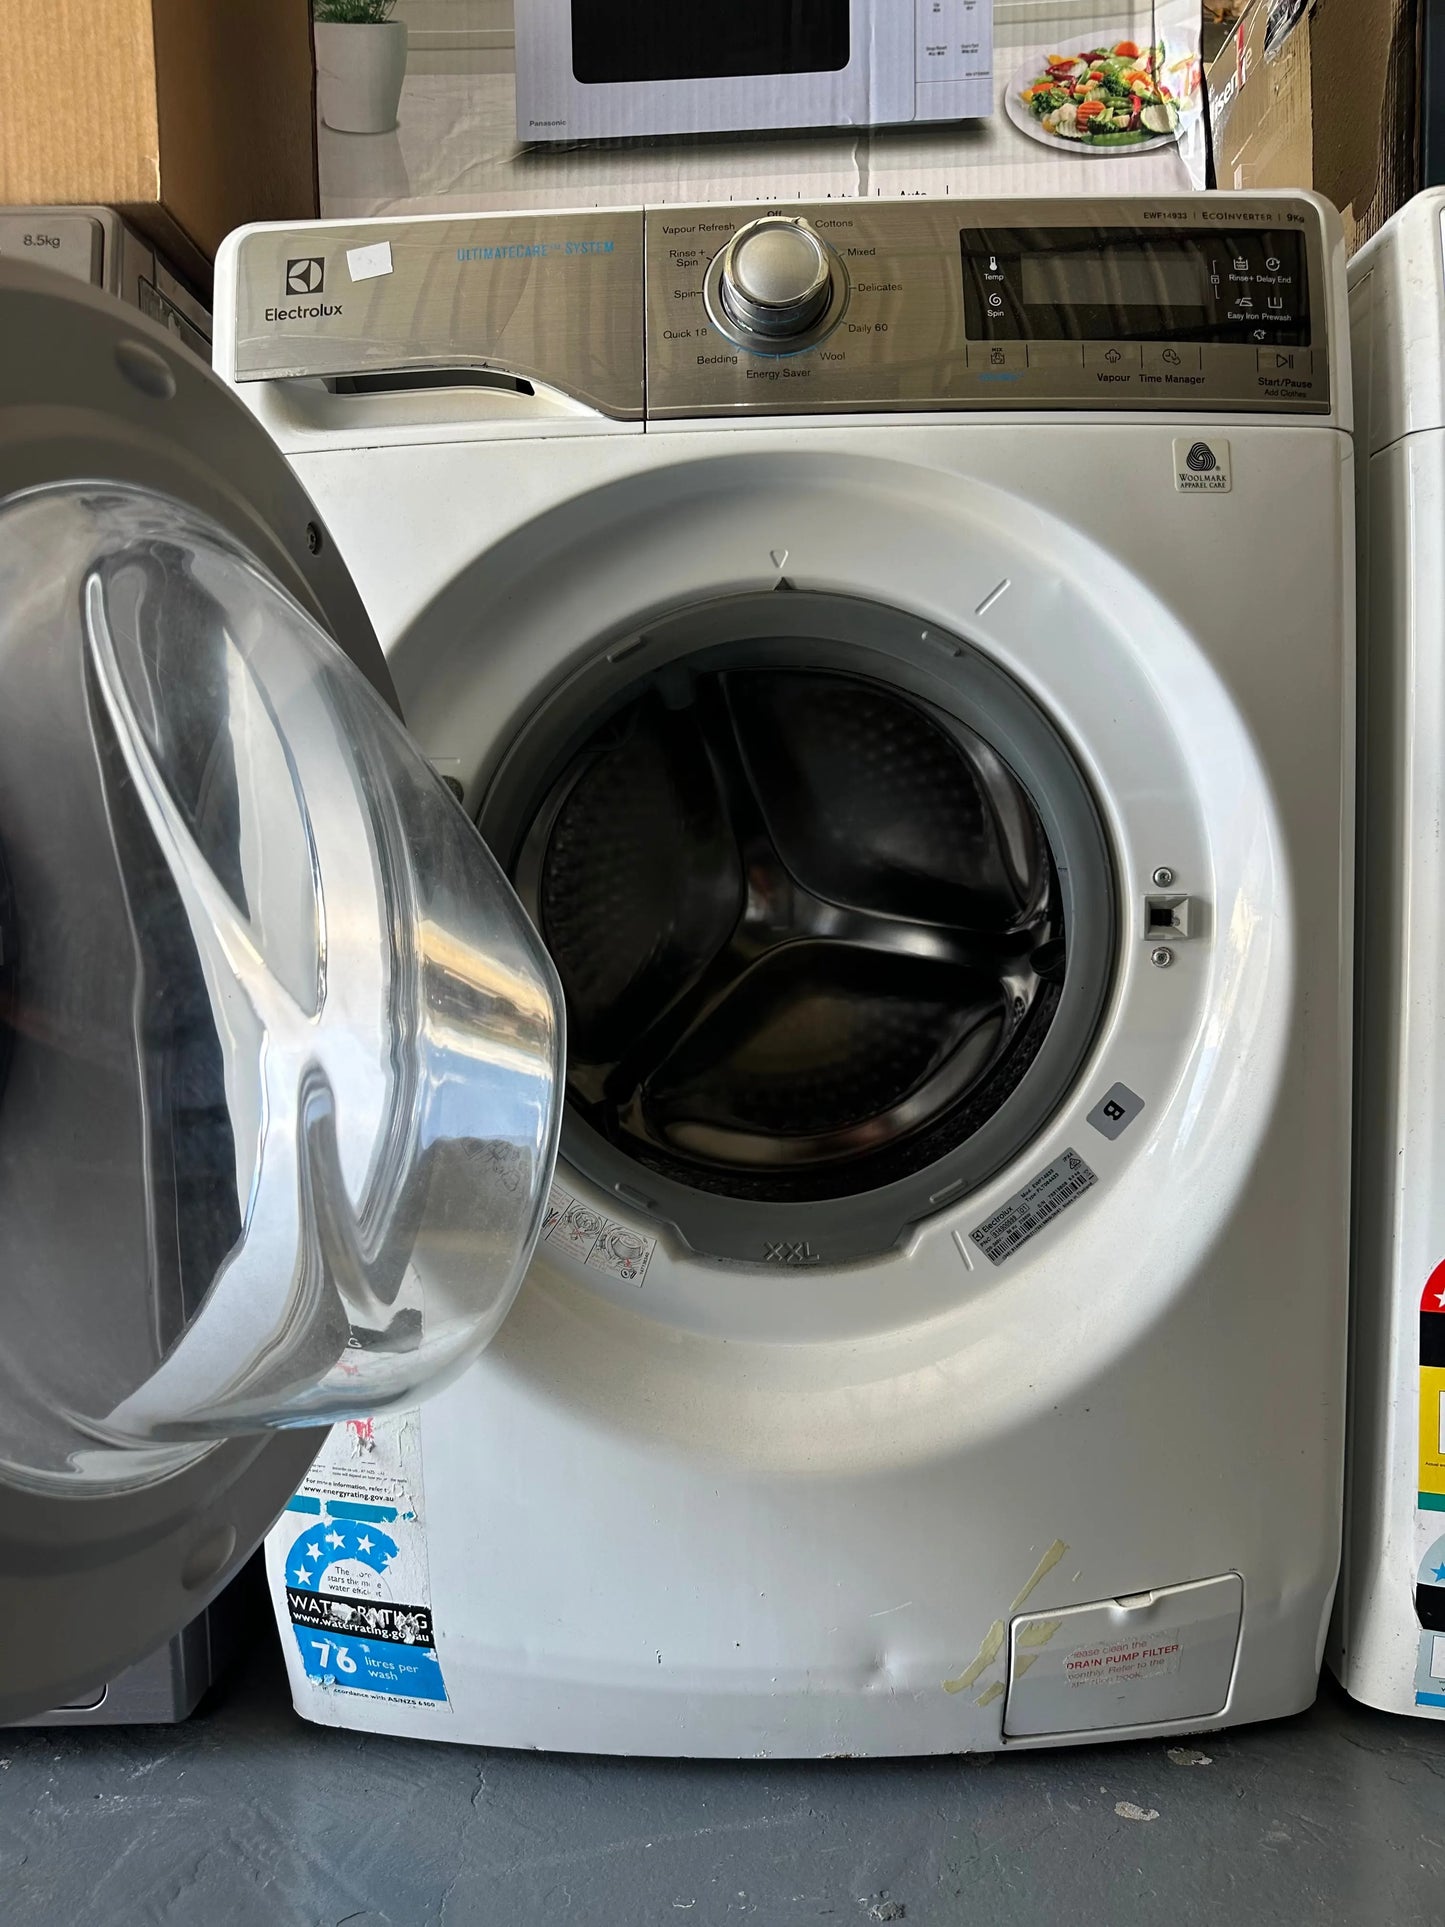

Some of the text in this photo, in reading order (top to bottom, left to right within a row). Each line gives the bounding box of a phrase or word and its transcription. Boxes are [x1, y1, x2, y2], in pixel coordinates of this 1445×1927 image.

[529, 119, 567, 127] Panasonic
[1143, 211, 1188, 220] EWF14933
[662, 222, 736, 236] Vapour Refresh
[815, 219, 853, 228] Cottons
[23, 234, 61, 249] 8.5kg
[565, 240, 615, 255] SYSTEM
[847, 247, 877, 256] Mixed
[669, 249, 696, 258] Rinse
[676, 258, 699, 269] Spin
[984, 273, 1004, 281] Temp
[1256, 275, 1292, 284] Delay End
[858, 283, 903, 292] Delicates
[674, 290, 696, 300] Spin
[265, 303, 343, 322] Electrolux
[987, 309, 1005, 318] Spin
[1227, 311, 1259, 321] Easy Iron
[1261, 313, 1292, 321] Prewash
[663, 328, 708, 340] Quick 18
[848, 323, 888, 334] Daily 60
[697, 355, 739, 366] Bedding
[820, 351, 846, 361] Wool
[746, 367, 811, 380] Energy Saver
[1097, 372, 1131, 383] Vapour
[1139, 374, 1205, 385] Time Manager
[1258, 377, 1312, 389] Start/Pause
[1264, 388, 1307, 398] Add Clothes
[1179, 473, 1227, 482] WOOLMARK
[1103, 1099, 1126, 1121] B
[982, 1205, 1013, 1233] Electrolux
[763, 1241, 820, 1263] XXL
[333, 1481, 367, 1491] information,
[335, 1565, 350, 1576] The
[327, 1575, 345, 1584] stars
[328, 1583, 350, 1593] water
[1102, 1643, 1129, 1654] clean
[1132, 1640, 1147, 1649] the
[310, 1640, 358, 1674] 76
[1105, 1652, 1139, 1664] PUMP
[1142, 1644, 1179, 1658] FILTER
[364, 1656, 419, 1674] litres per
[1137, 1662, 1147, 1670] to
[1149, 1658, 1165, 1667] the
[368, 1670, 399, 1681] wash
